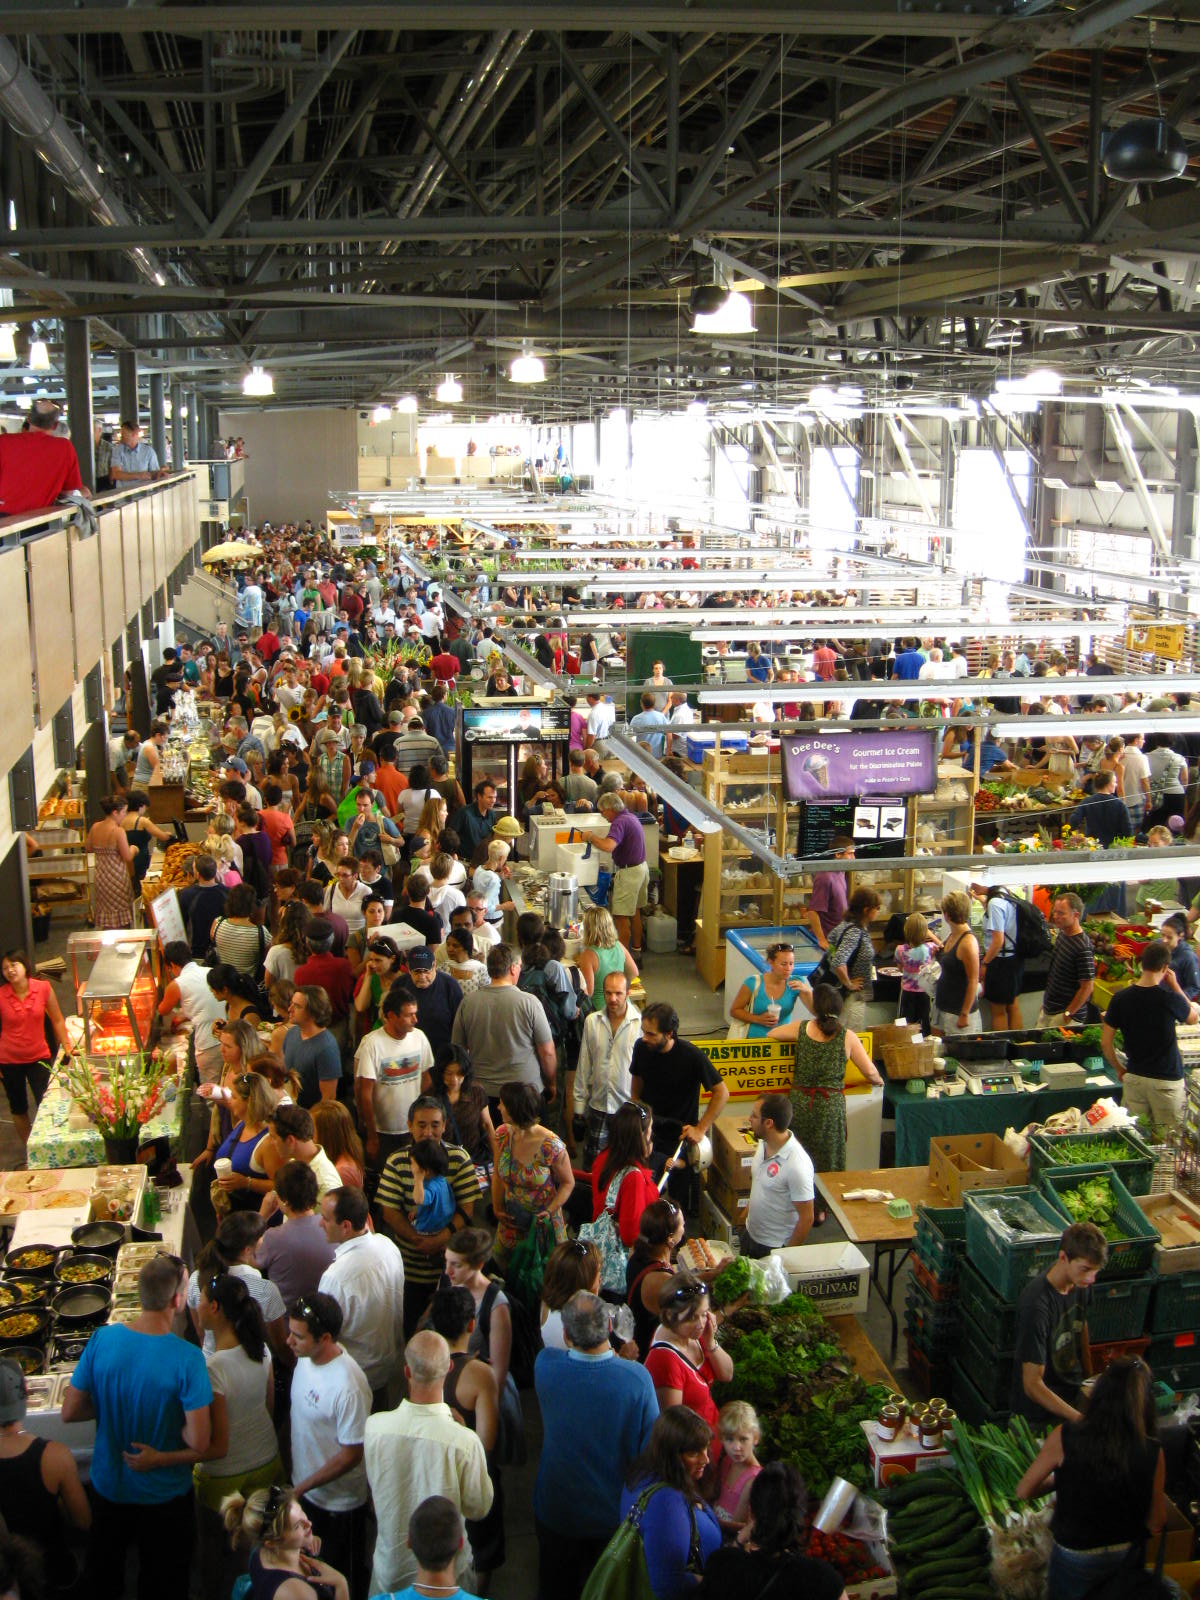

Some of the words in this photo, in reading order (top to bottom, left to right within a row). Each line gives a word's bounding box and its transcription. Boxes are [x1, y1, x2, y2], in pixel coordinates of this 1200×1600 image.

[792, 743, 811, 755] Dee
[813, 741, 840, 753] Dee's
[852, 748, 883, 757] Gourmet
[897, 747, 920, 755] Cream
[702, 1045, 771, 1059] PASTURE
[780, 1044, 796, 1056] HI
[718, 1065, 766, 1077] GRASS
[736, 1077, 792, 1089] VEGETA
